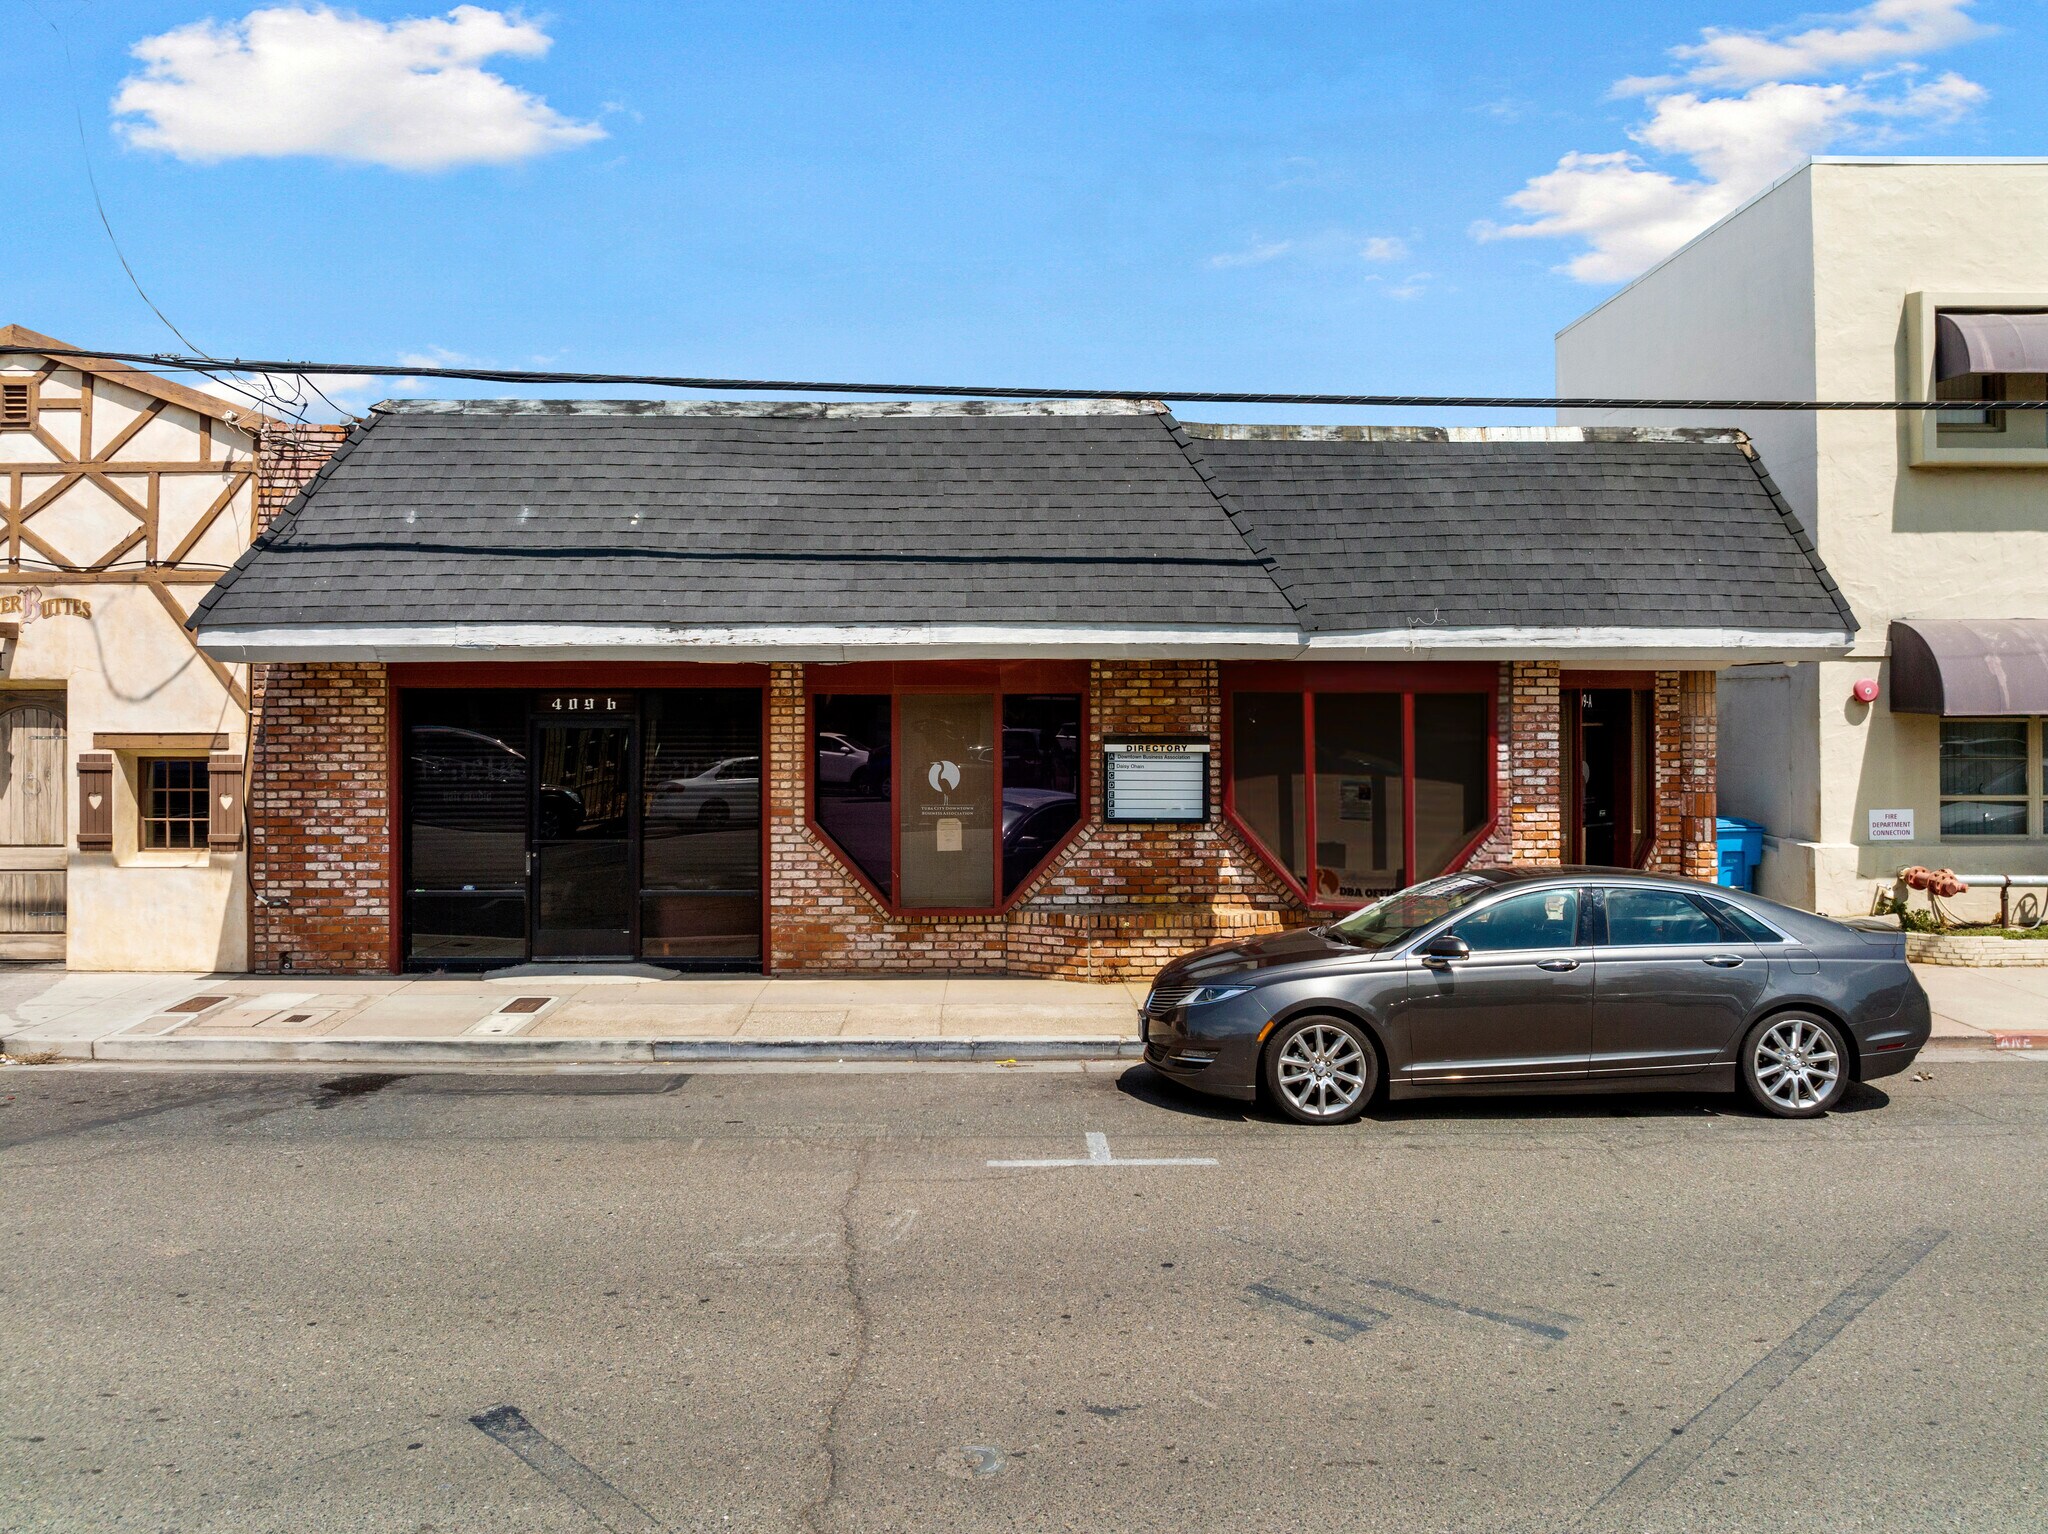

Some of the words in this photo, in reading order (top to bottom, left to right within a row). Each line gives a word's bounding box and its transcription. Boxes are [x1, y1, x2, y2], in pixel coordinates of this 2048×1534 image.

[0, 595, 23, 615] ER
[1126, 744, 1188, 752] DIRECTORY
[1340, 886, 1363, 897] DBA
[1365, 887, 1402, 898] OFFIC
